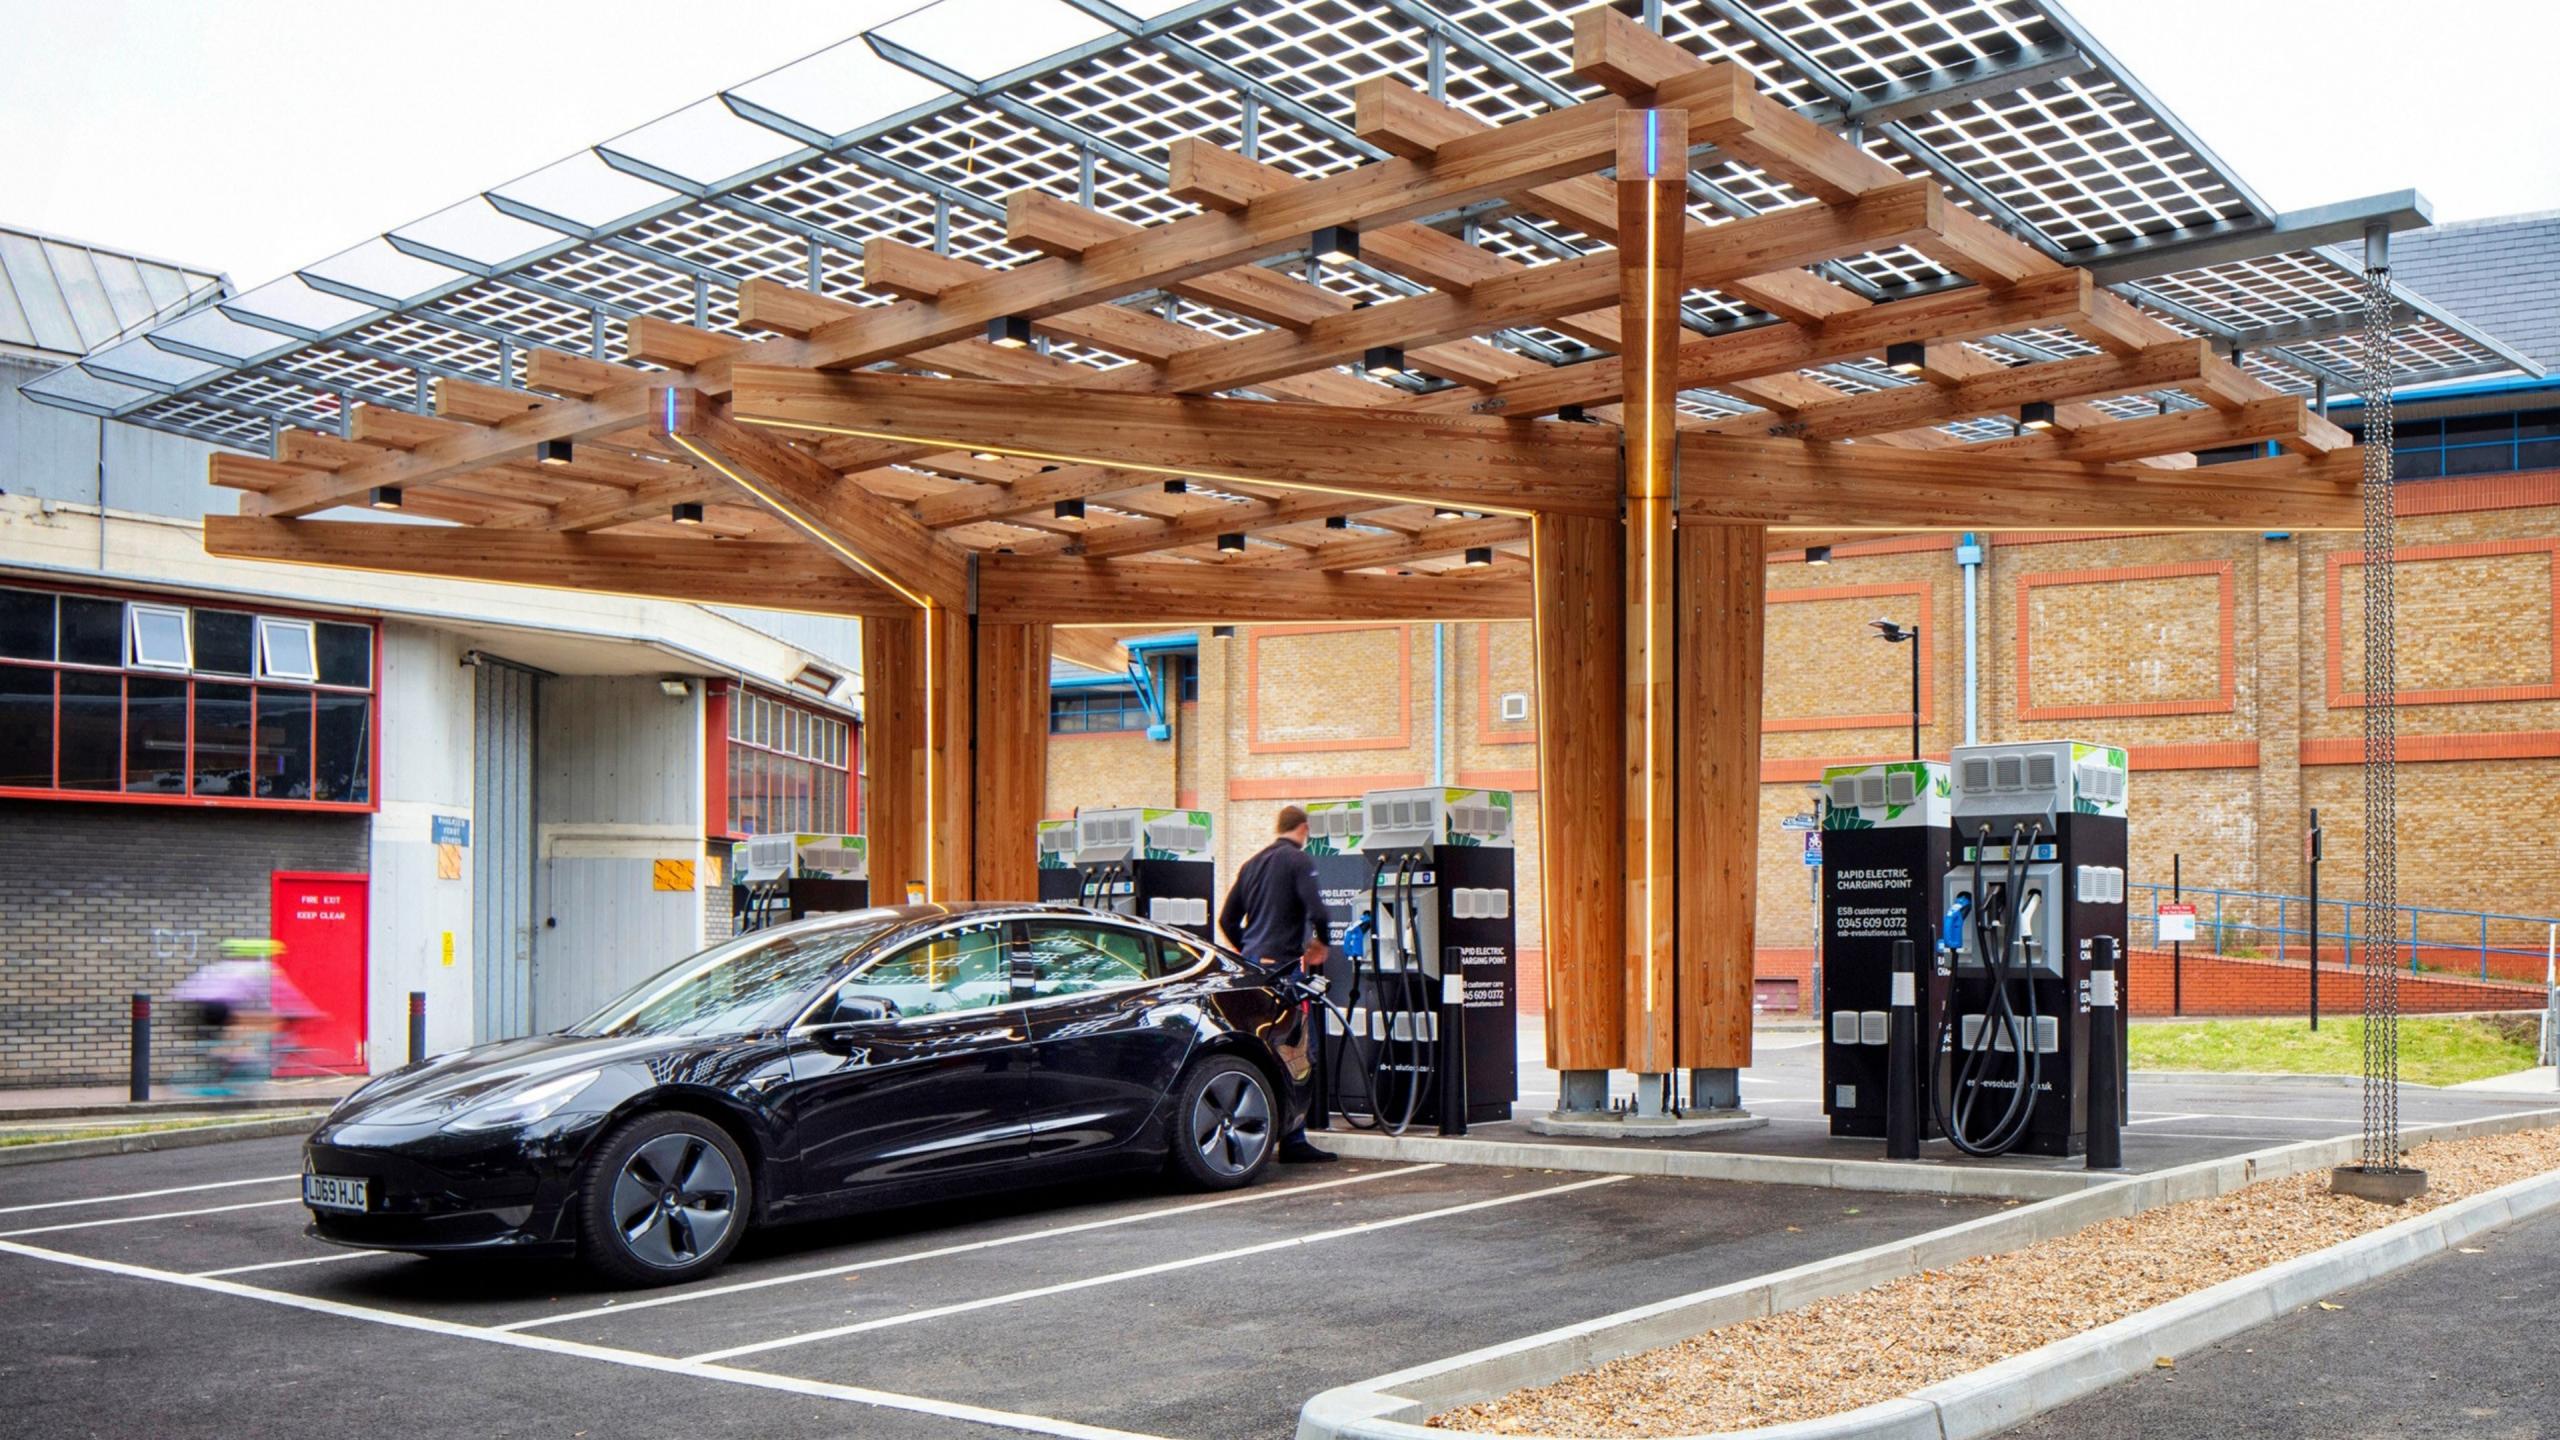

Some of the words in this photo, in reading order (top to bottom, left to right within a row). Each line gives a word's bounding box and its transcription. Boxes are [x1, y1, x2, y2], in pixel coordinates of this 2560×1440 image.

[1837, 870, 1864, 879] RAPID
[1865, 868, 1908, 878] ELECTRIC
[1837, 881, 1883, 890] CHARGING
[1884, 879, 1912, 889] POINT
[301, 895, 319, 904] FIRE
[323, 895, 341, 904] EXIT
[296, 911, 318, 920] KEEP
[319, 911, 346, 920] CLEAR
[1837, 907, 1853, 915] ESB
[1837, 918, 1861, 928] 0345
[1863, 918, 1882, 928] 609
[1883, 918, 1907, 928] 0372
[1475, 946, 1505, 956] ELECTRIC
[1488, 956, 1507, 965] POINT
[1473, 990, 1487, 1000] 609
[1487, 989, 1504, 999] 0372
[309, 1179, 336, 1202] LD69
[338, 1182, 365, 1206] HJC
